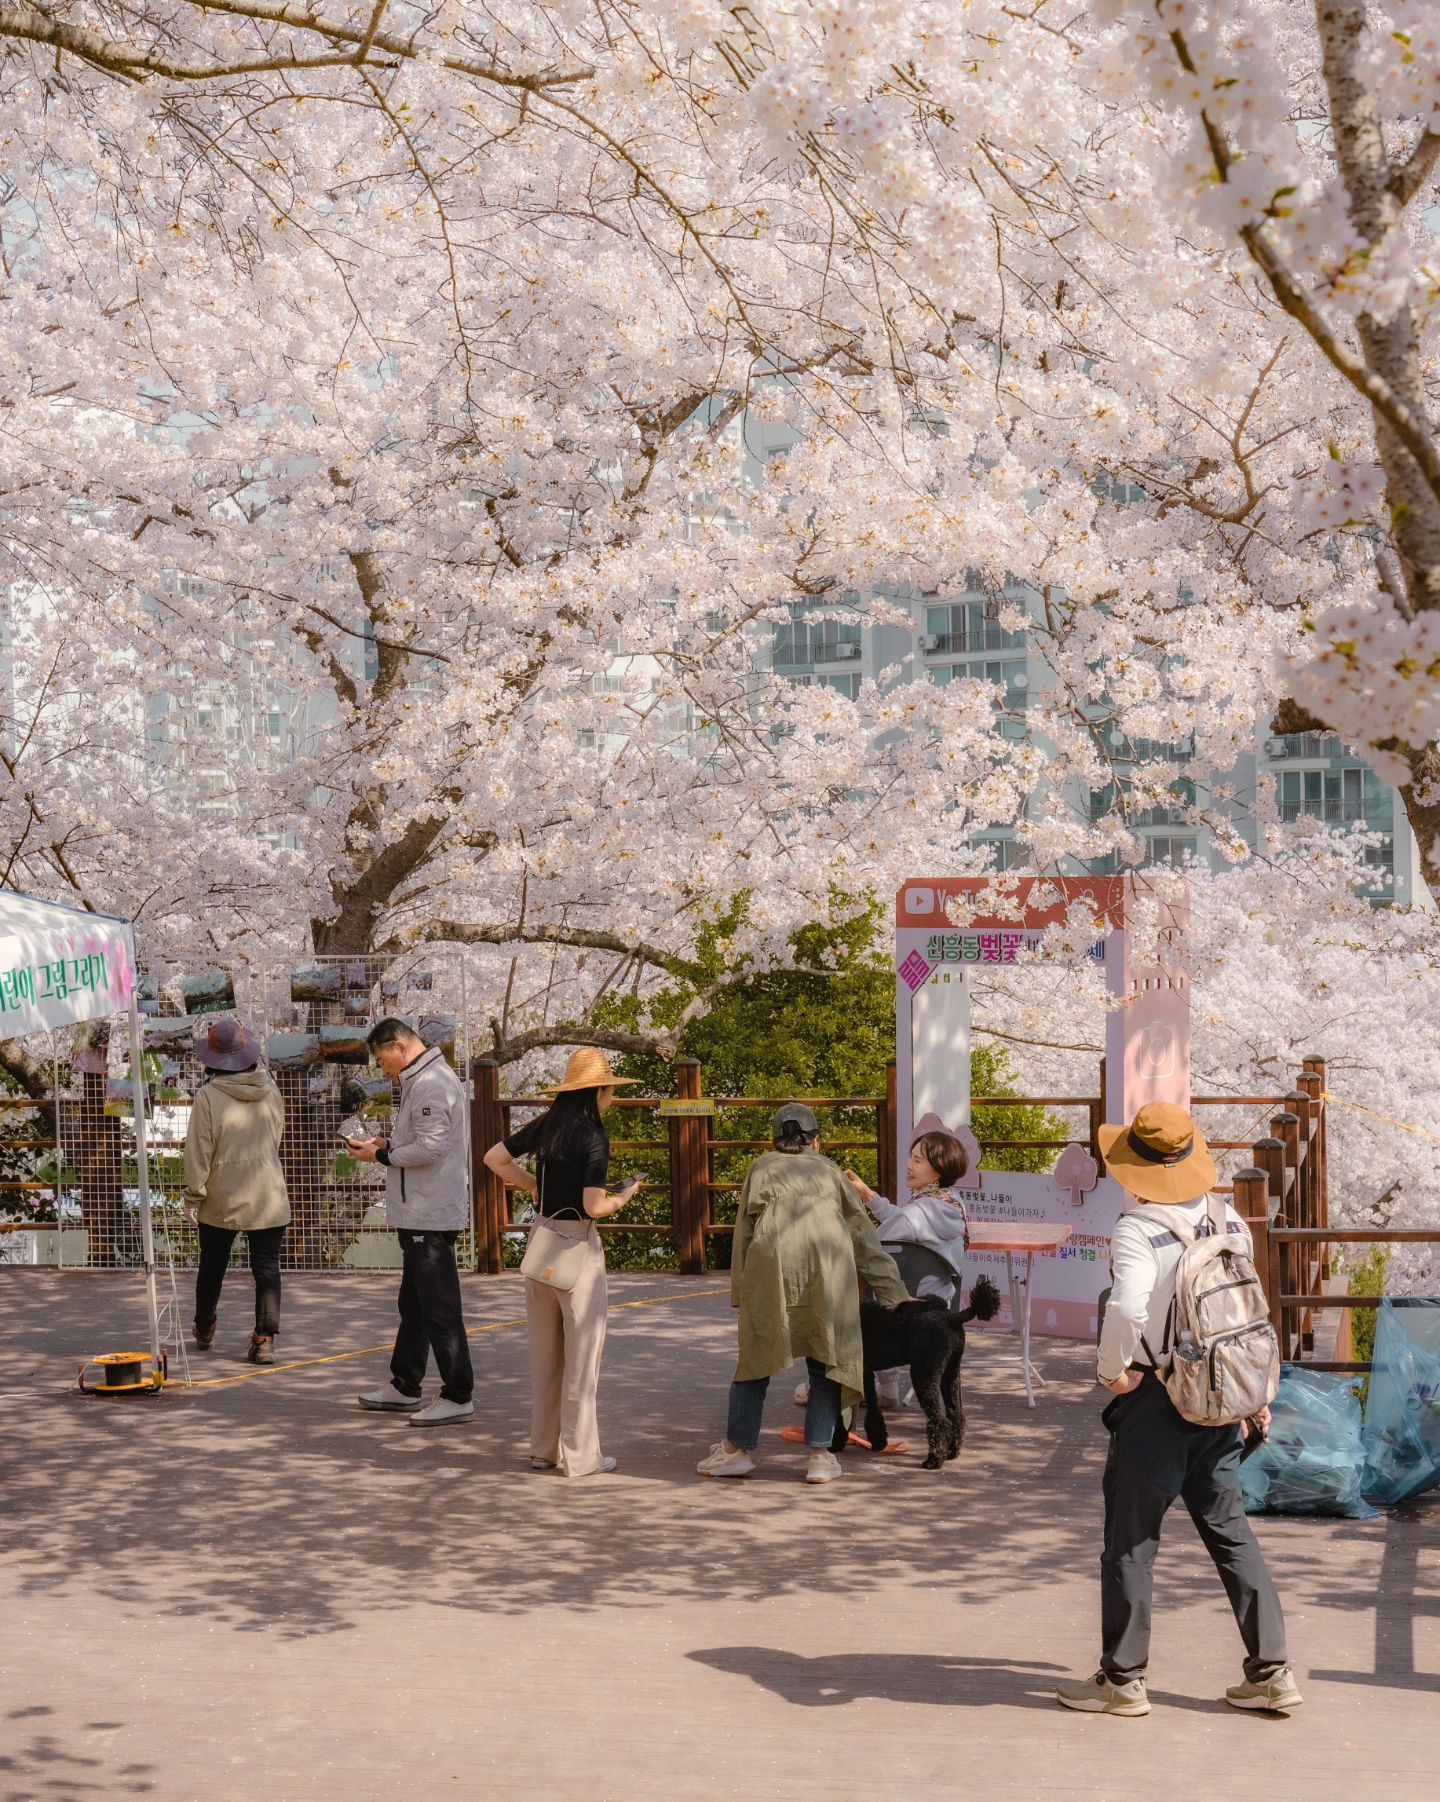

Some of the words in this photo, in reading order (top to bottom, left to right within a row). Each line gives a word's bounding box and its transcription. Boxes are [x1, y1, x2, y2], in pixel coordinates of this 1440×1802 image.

[38, 952, 109, 1000] 그림그리기
[959, 1190, 1013, 1204] 흥동벚꽃_나들이
[1066, 1233, 1105, 1248] 랑캠페인
[1059, 1246, 1076, 1259] 질서
[1079, 1247, 1096, 1262] 청결
